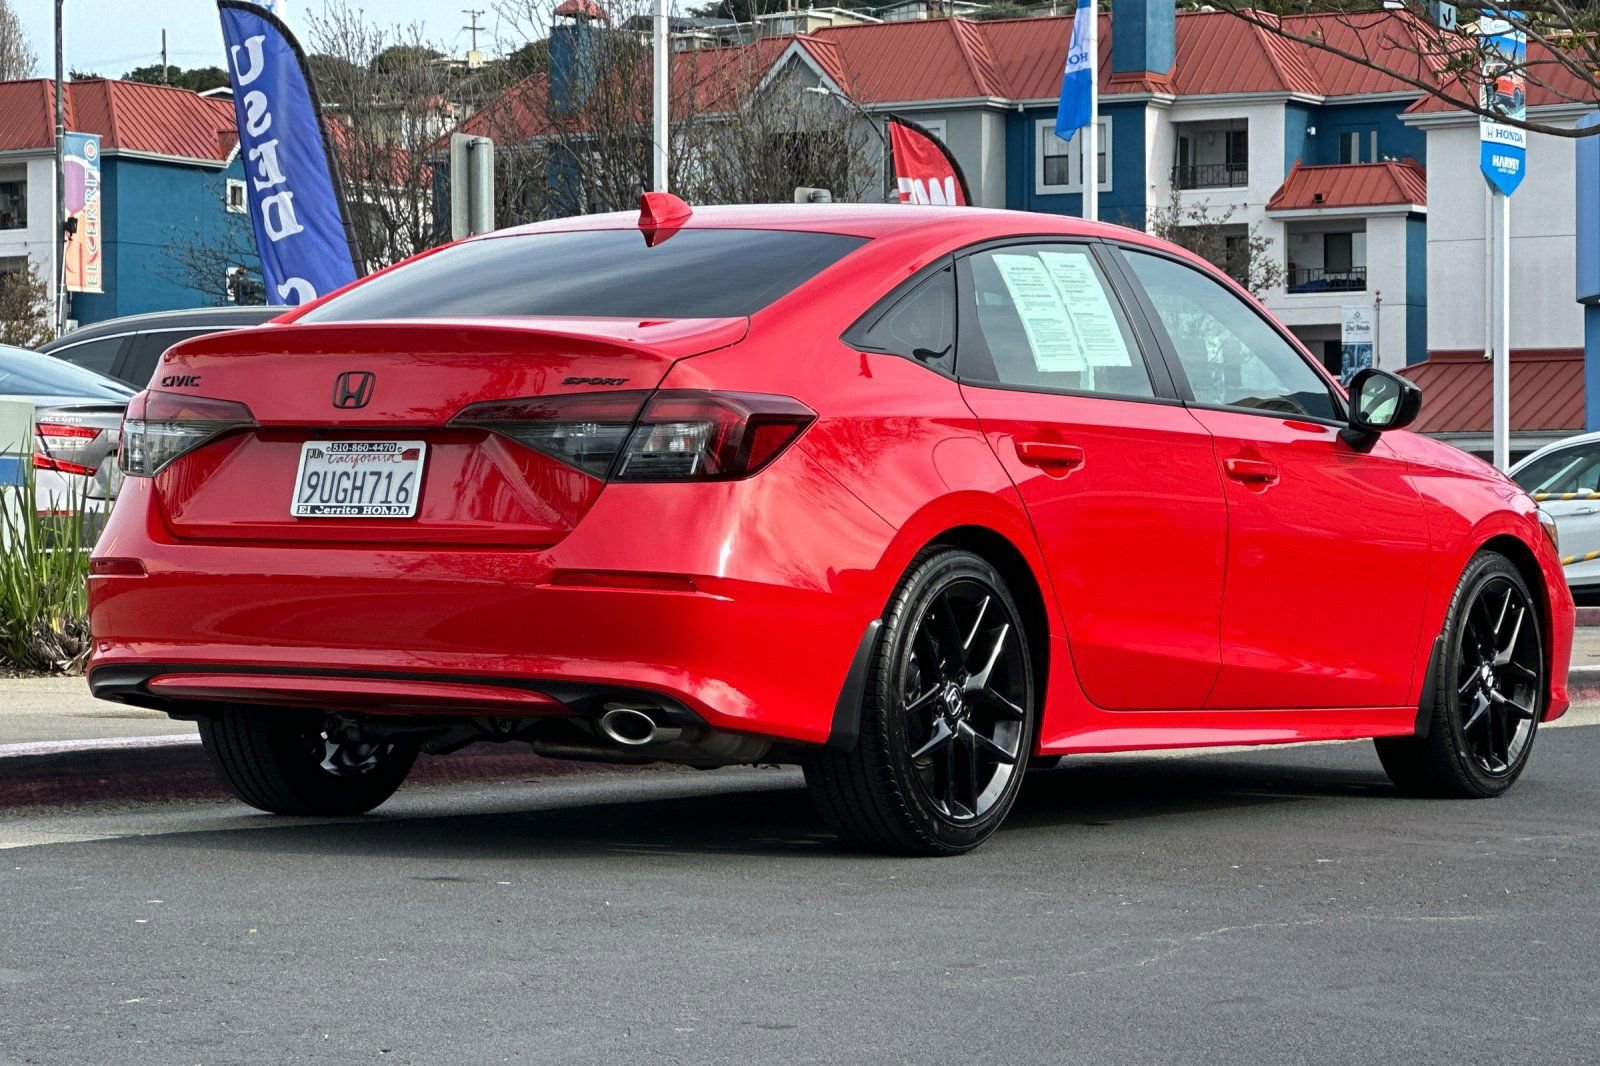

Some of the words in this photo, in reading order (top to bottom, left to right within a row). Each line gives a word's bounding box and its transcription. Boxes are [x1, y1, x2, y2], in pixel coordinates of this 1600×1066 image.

[1495, 129, 1523, 143] HONDA
[84, 139, 98, 253] CERRITO
[85, 262, 98, 286] EL
[161, 375, 202, 387] CIVIC
[561, 377, 631, 386] SPORT
[40, 415, 82, 424] ACCORD
[332, 443, 396, 452] 510-860-4470
[327, 453, 402, 469] California
[303, 470, 414, 504] 9UGH716
[298, 505, 311, 515] El
[362, 506, 408, 516] HONDA
